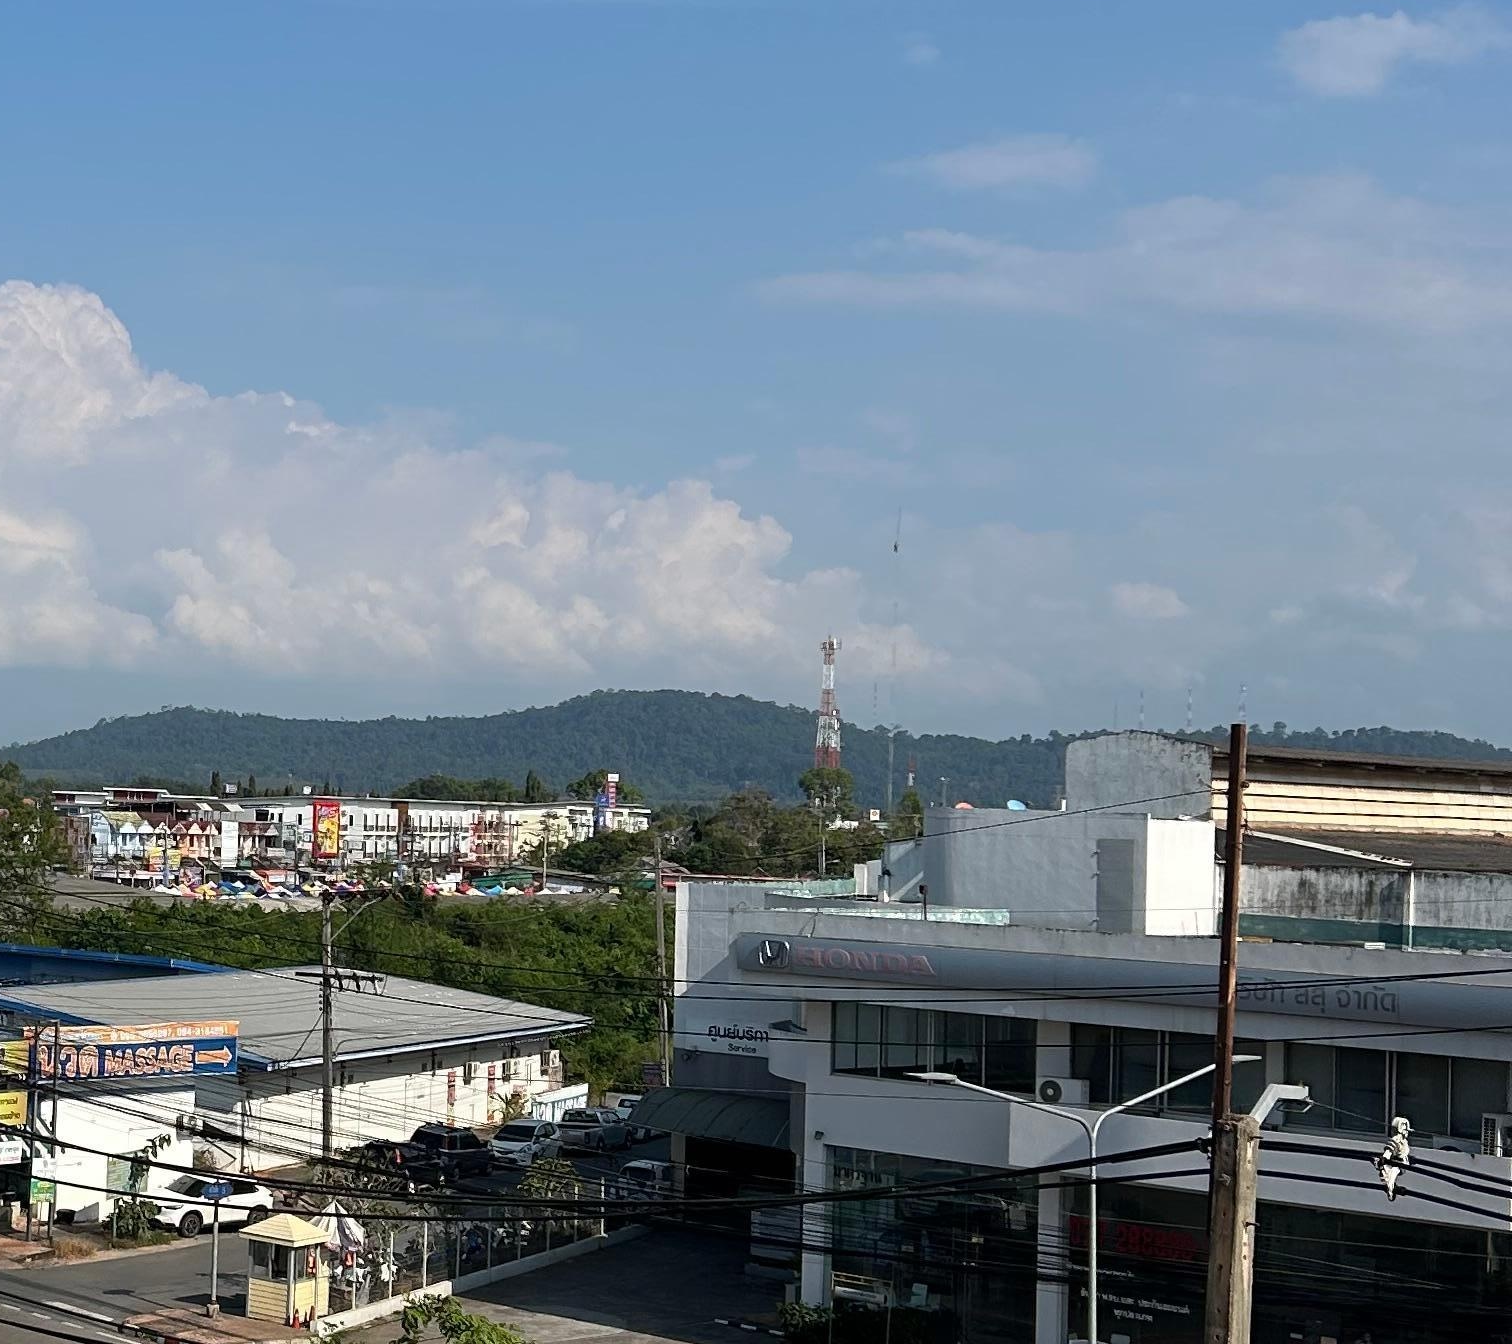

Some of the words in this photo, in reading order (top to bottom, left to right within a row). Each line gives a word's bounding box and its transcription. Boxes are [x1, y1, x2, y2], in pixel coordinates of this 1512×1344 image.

[794, 943, 938, 977] HONDA
[1335, 983, 1398, 1014] จำกัด
[37, 1044, 100, 1079] นวด
[103, 1043, 195, 1077] MASSAGE
[727, 1042, 757, 1054] Service
